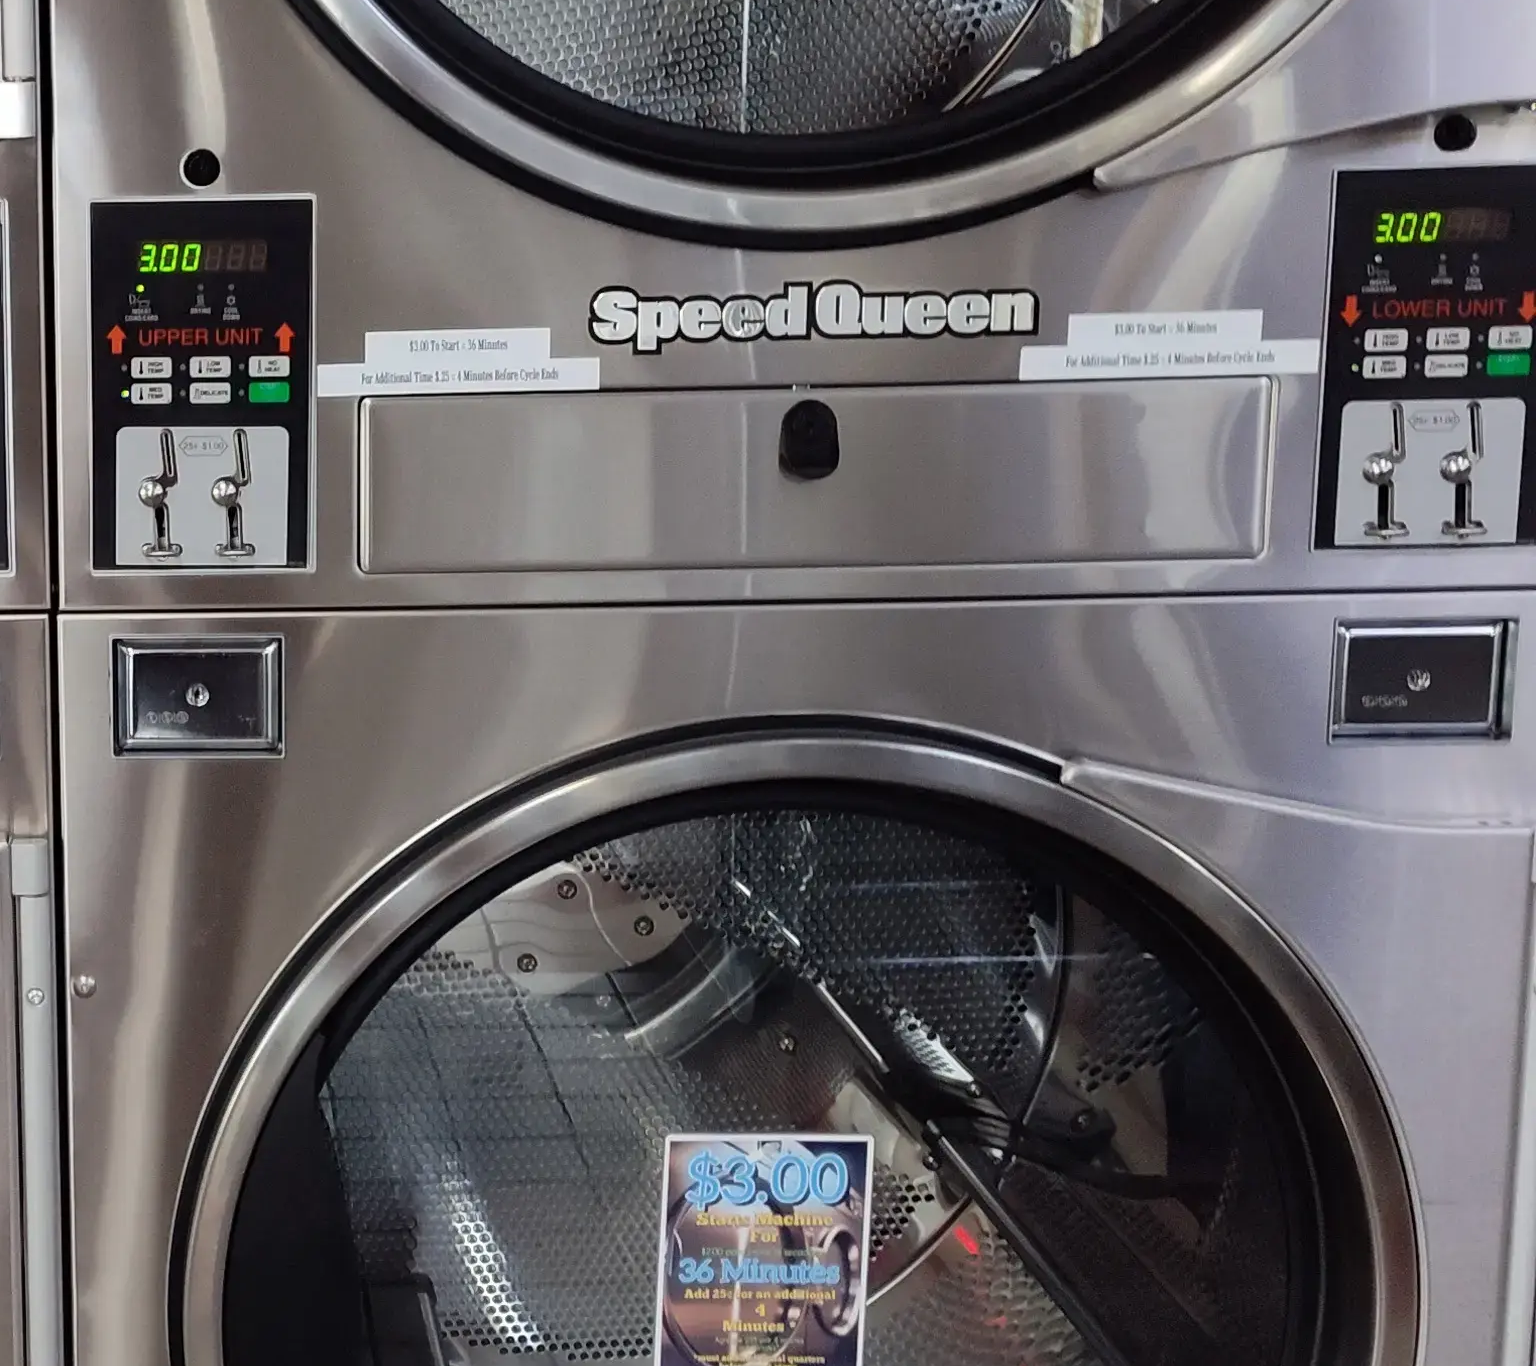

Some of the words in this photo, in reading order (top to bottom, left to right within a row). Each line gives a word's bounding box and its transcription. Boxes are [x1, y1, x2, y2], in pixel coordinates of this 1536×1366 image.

[1375, 211, 1442, 243] 3.00
[139, 243, 201, 273] 3.00
[588, 281, 812, 355] Speed
[814, 279, 1039, 339] Queen
[1372, 299, 1450, 319] LOWER
[1458, 298, 1508, 317] UNIT
[139, 328, 209, 347] UPPER
[216, 327, 263, 345] UNIT
[409, 340, 429, 352] $3.00
[442, 340, 459, 351] Start
[478, 340, 507, 350] Minutes
[361, 373, 373, 384] For
[375, 371, 412, 384] Additional
[414, 372, 432, 382] Time
[463, 370, 493, 381] Minutes
[495, 368, 518, 381] Before
[520, 368, 540, 381] Cycle
[541, 368, 558, 379] Ends
[685, 1150, 849, 1212] $3.00
[696, 1212, 750, 1227] Starts
[755, 1210, 833, 1227] Machine
[750, 1229, 779, 1243] For
[678, 1256, 715, 1285] 36
[720, 1257, 841, 1285] Minutes
[684, 1288, 710, 1300] Add
[755, 1290, 771, 1299] an
[774, 1288, 836, 1300] additional
[755, 1303, 766, 1317] 4
[723, 1320, 785, 1333] Minutes
[788, 1355, 826, 1365] quarters
